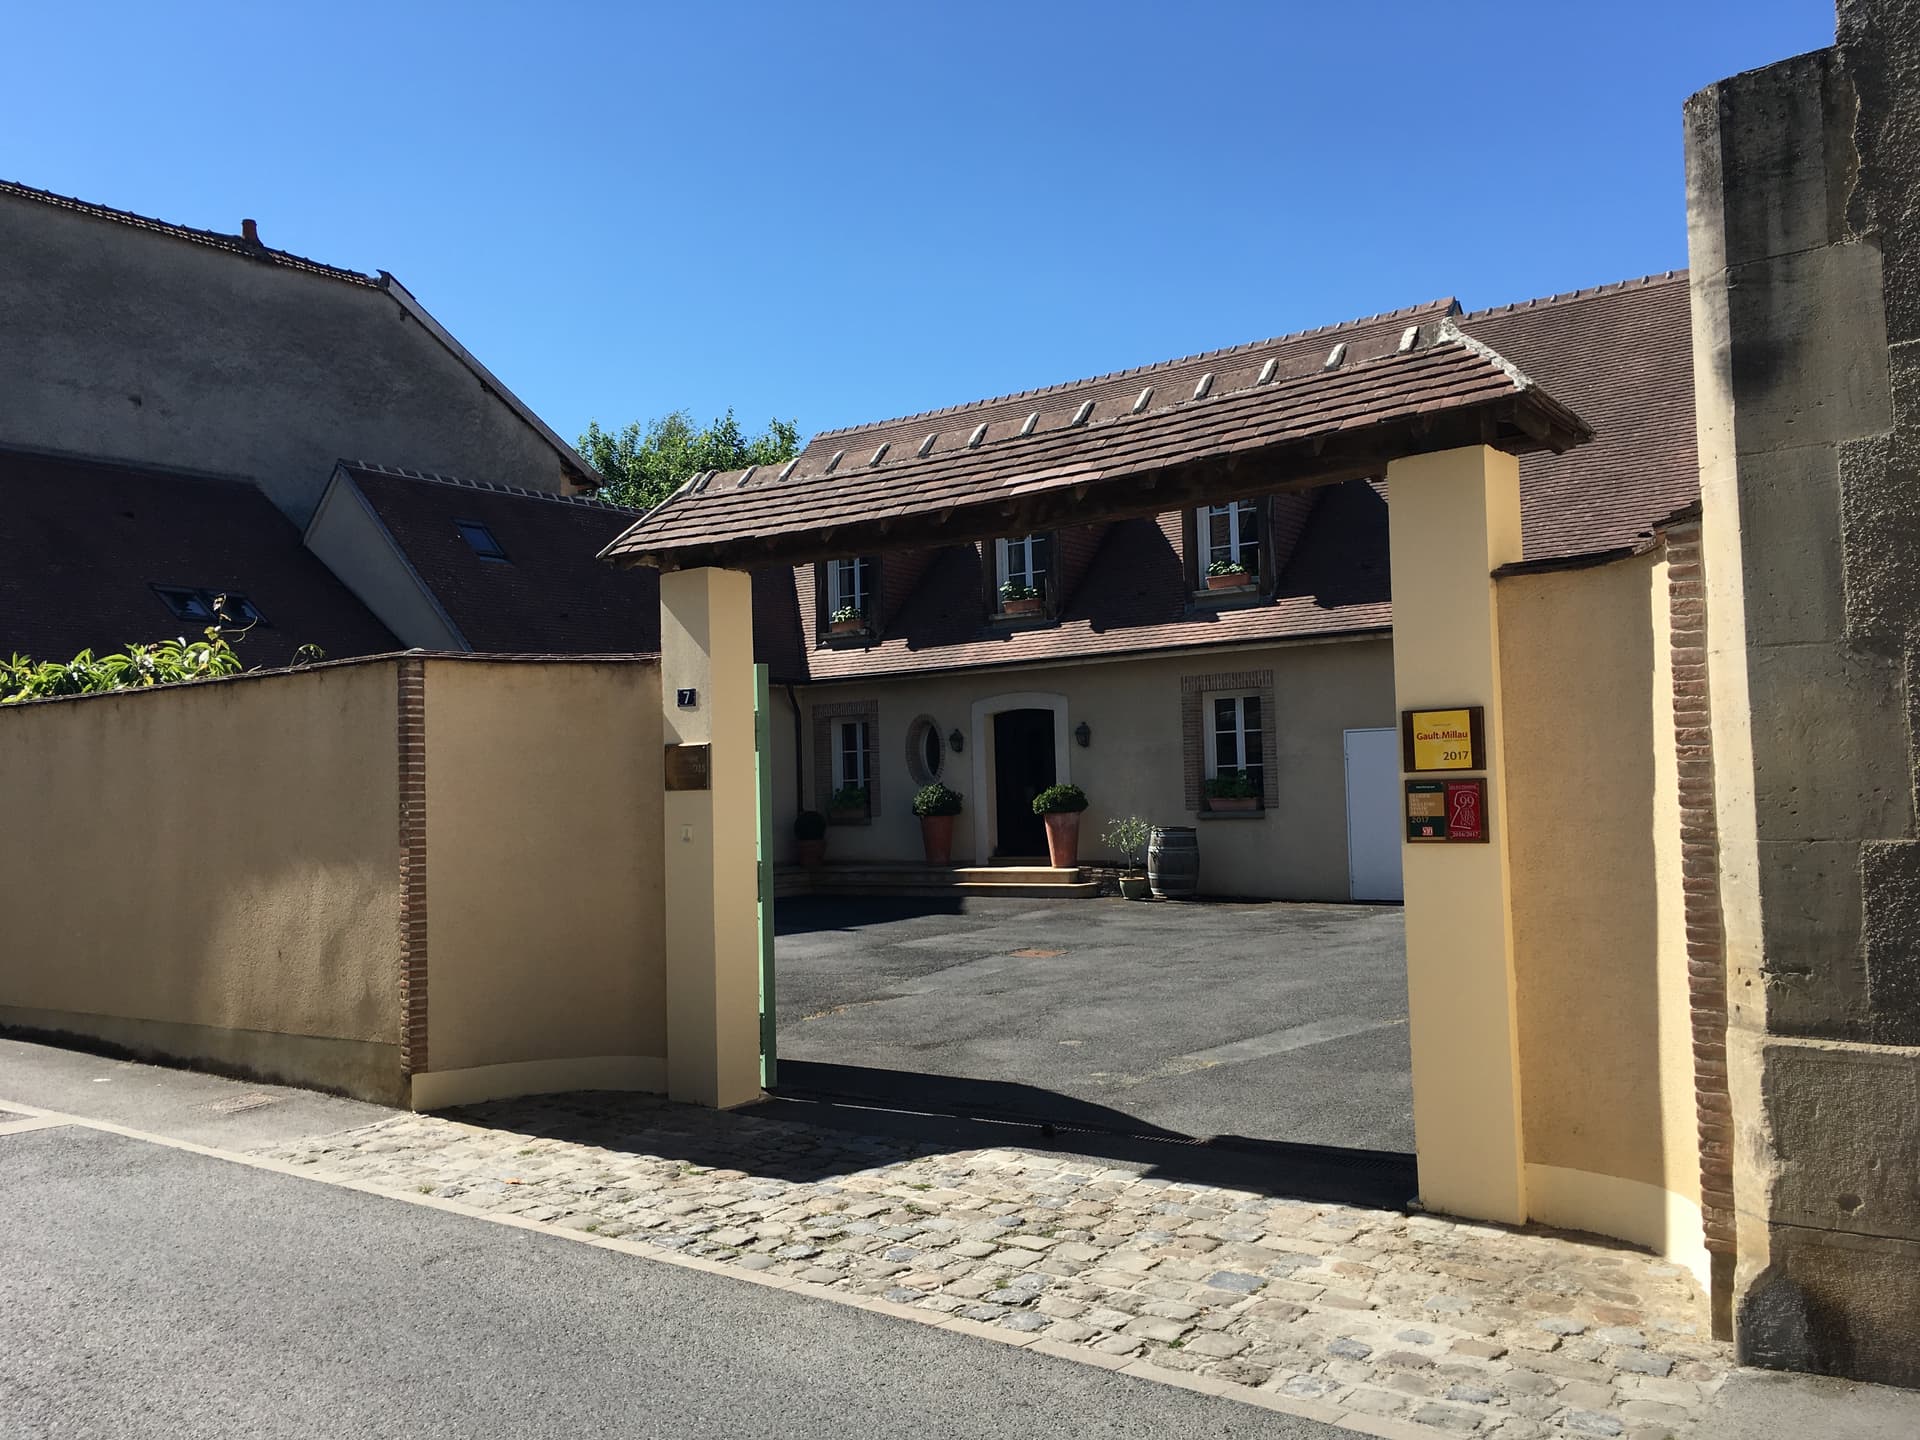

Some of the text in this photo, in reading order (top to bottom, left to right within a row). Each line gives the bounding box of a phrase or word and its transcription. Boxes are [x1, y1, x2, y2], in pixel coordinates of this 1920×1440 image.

[683, 690, 690, 704] 7
[1443, 751, 1469, 761] 2017
[1411, 816, 1429, 824] 2017
